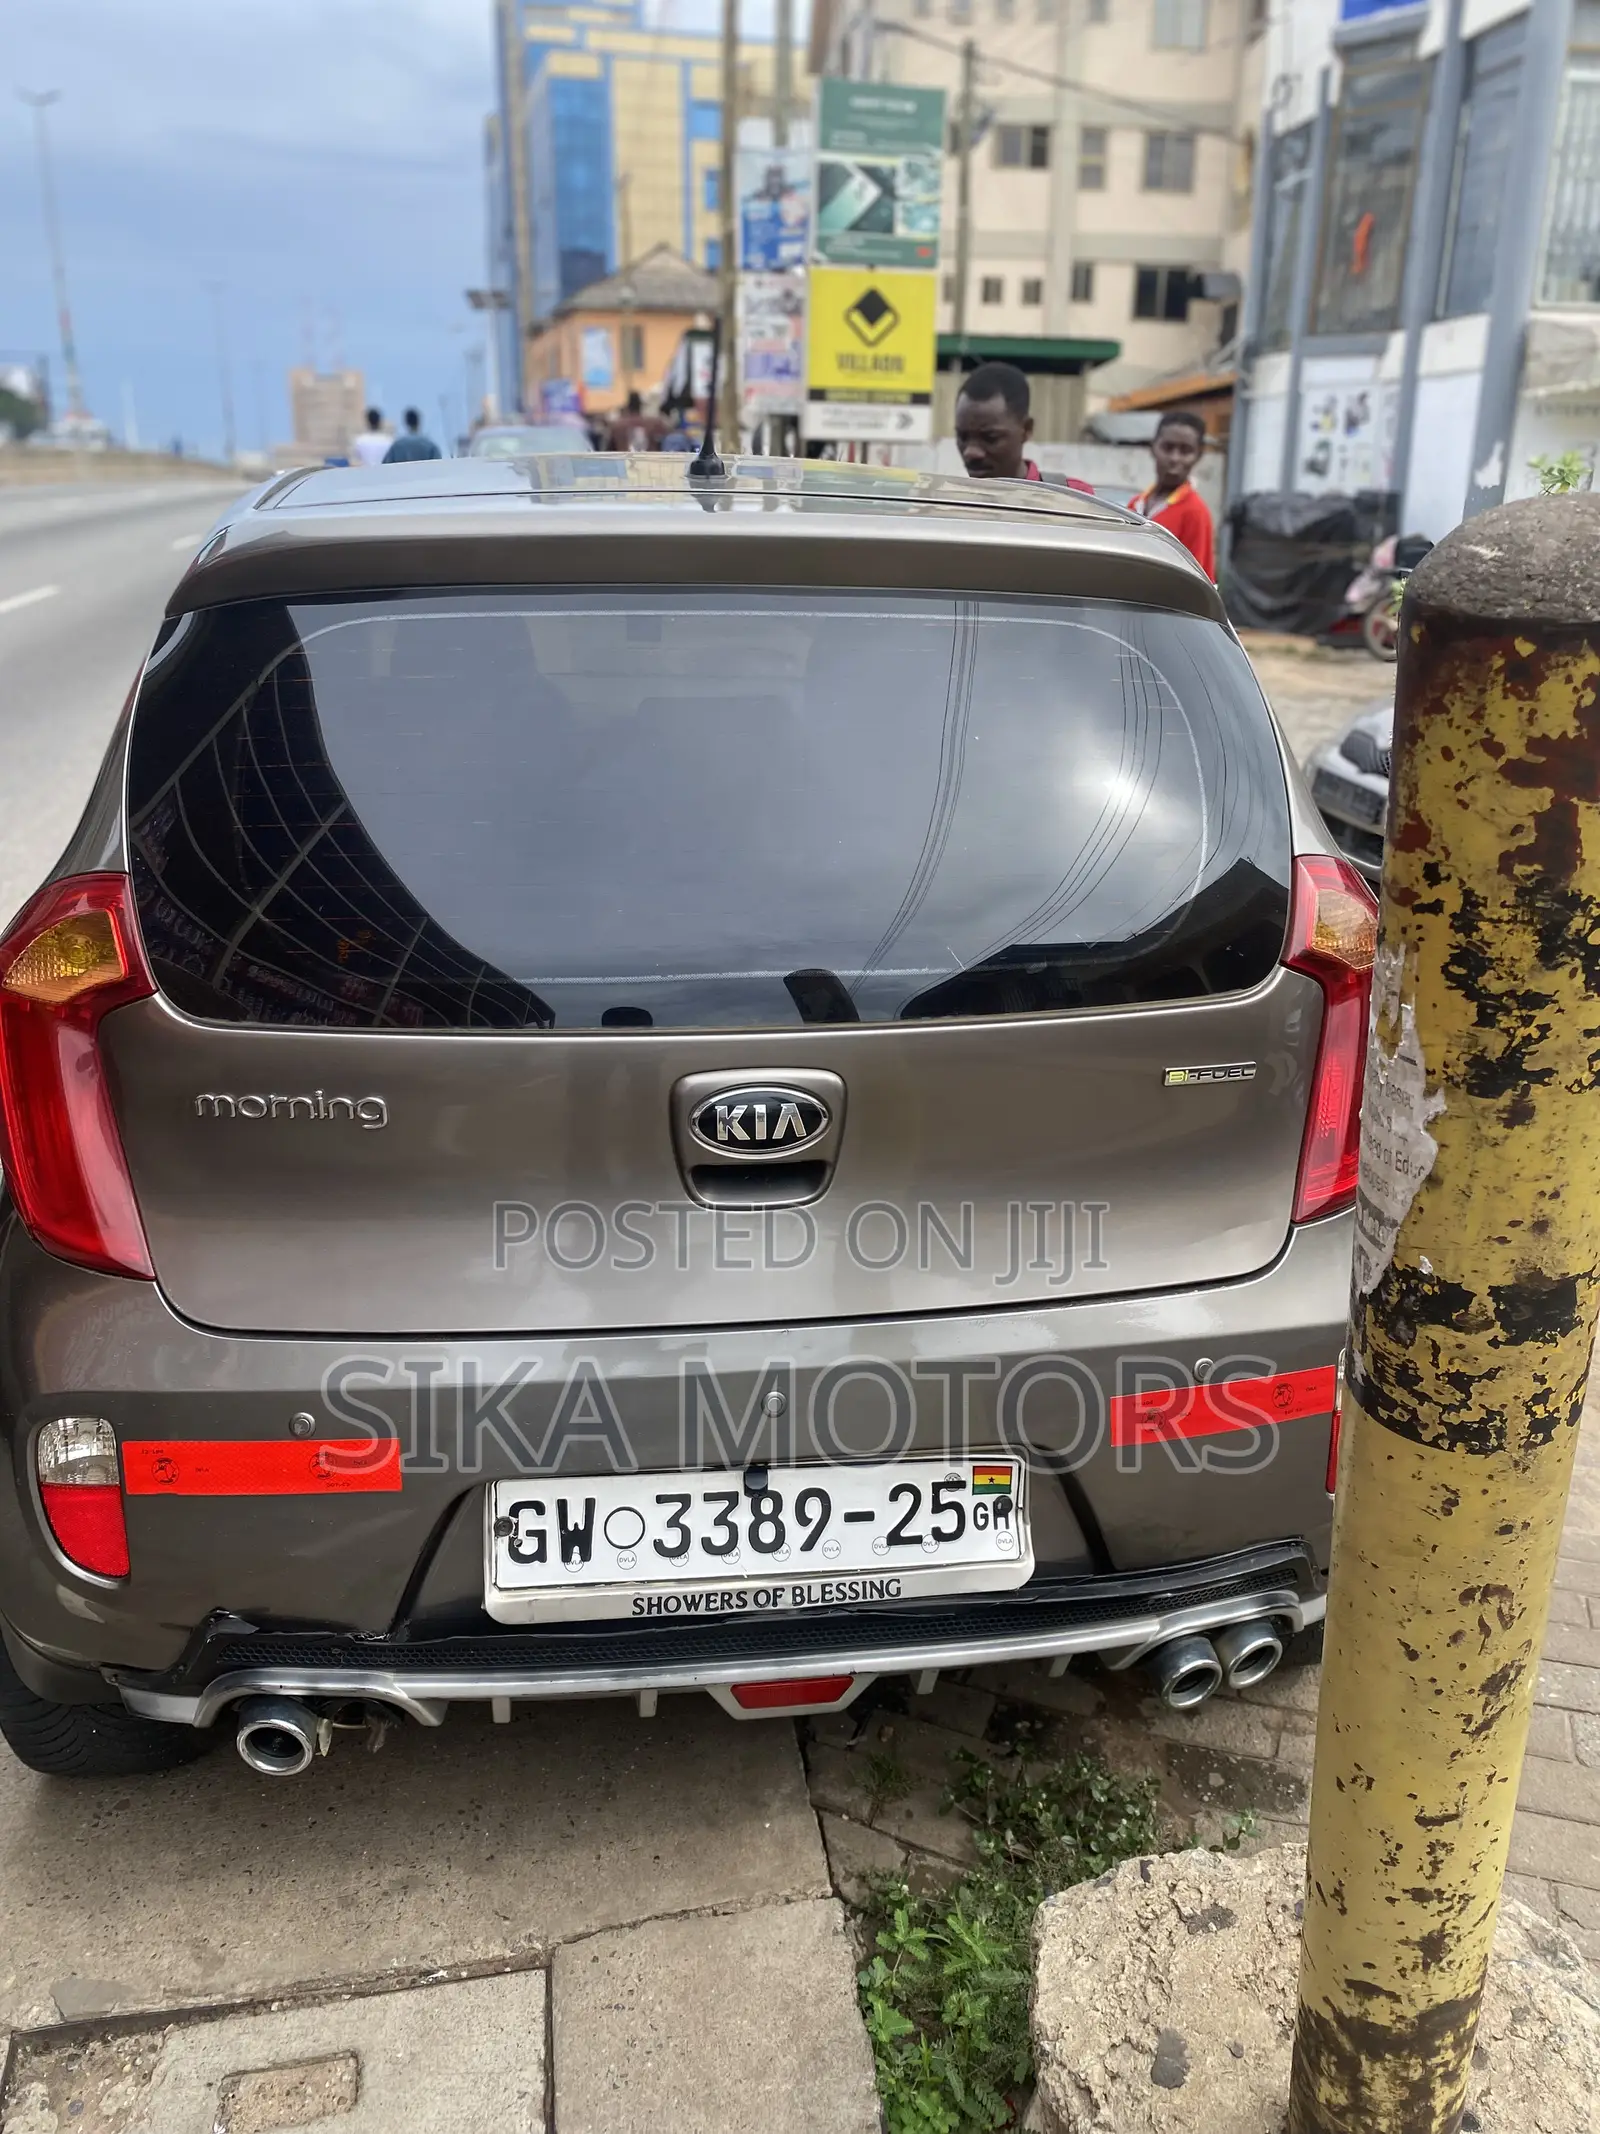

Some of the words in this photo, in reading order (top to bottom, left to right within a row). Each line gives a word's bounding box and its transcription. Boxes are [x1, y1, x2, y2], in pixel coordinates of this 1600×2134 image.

[1168, 1066, 1254, 1082] Bi-FUEL
[195, 1088, 389, 1129] morning
[715, 1103, 807, 1140] KIA
[508, 1497, 596, 1564] GW
[653, 1480, 967, 1558] 3389-25
[632, 1590, 748, 1616] SHOWERS
[753, 1588, 785, 1608] OF
[791, 1578, 902, 1606] BLESSING
